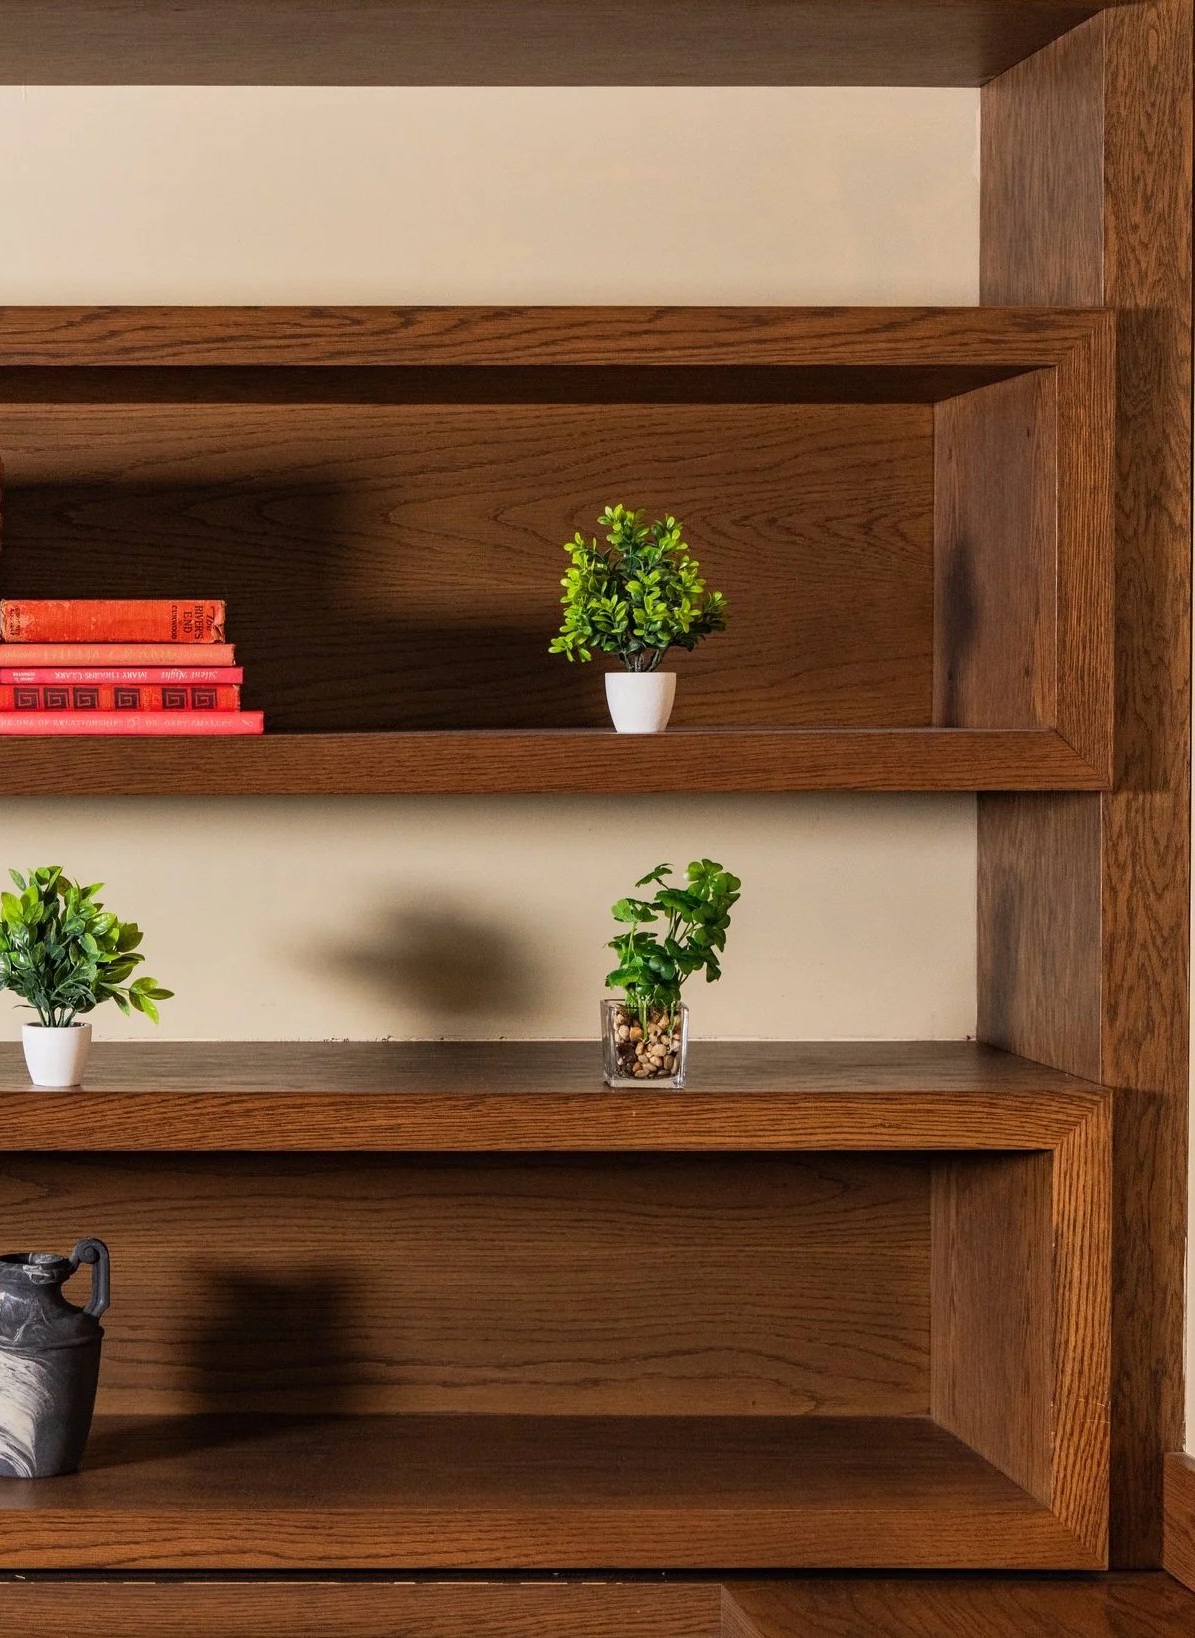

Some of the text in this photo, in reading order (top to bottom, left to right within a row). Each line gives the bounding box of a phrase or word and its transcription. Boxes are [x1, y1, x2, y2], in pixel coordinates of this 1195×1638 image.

[183, 611, 192, 633] END
[195, 605, 204, 640] RIVER'S
[54, 671, 82, 681] CLARK
[123, 671, 148, 680] MARY
[161, 668, 187, 680] Night
